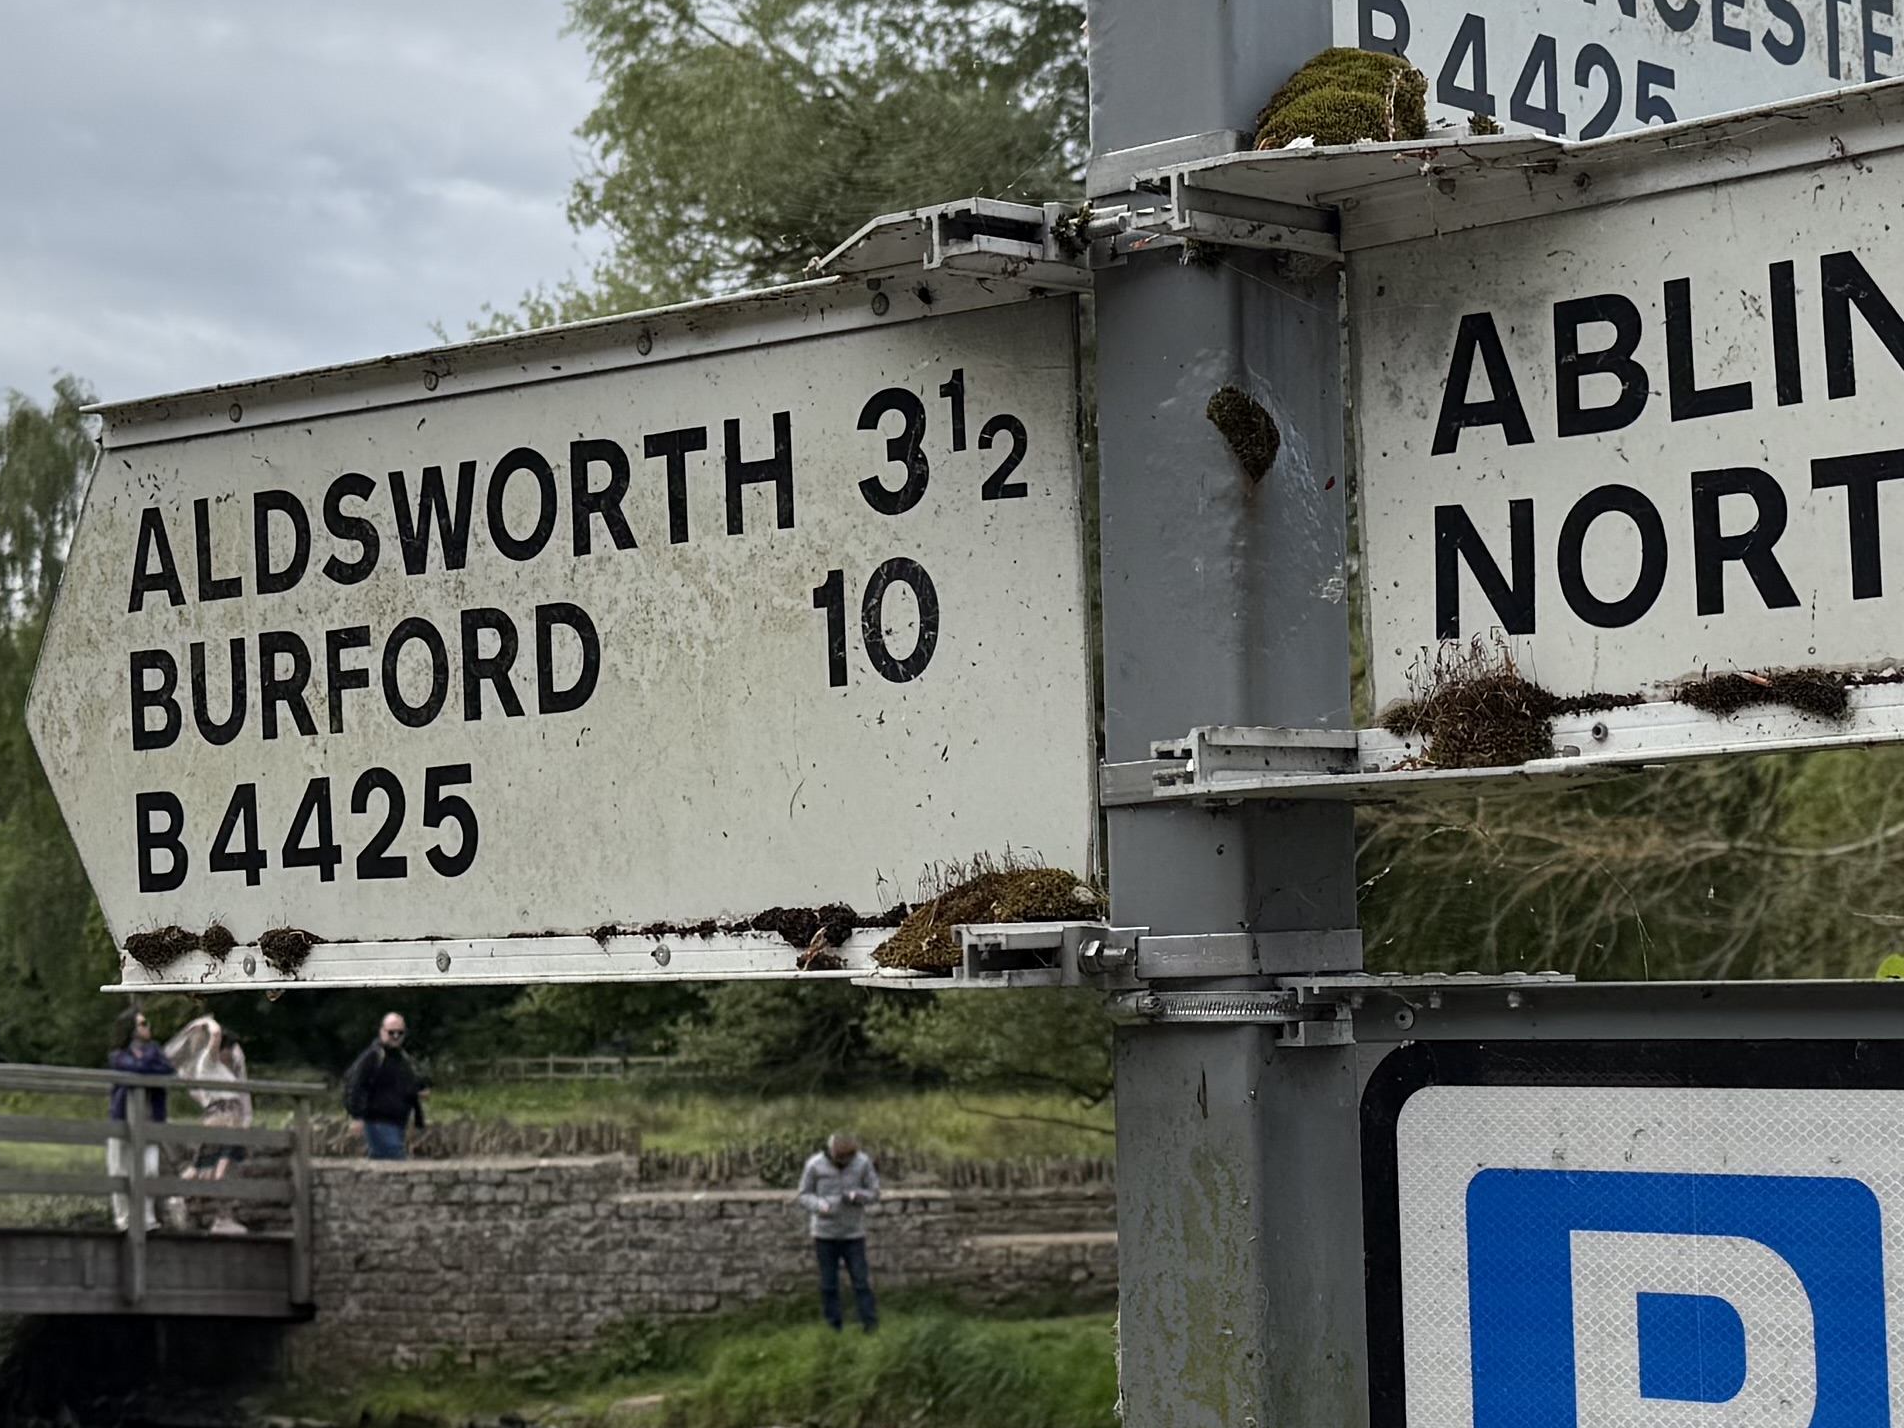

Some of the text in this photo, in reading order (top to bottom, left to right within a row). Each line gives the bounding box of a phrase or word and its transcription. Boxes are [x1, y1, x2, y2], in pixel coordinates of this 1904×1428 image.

[127, 410, 795, 614] ALDSWORTH
[129, 556, 940, 752] BURFORD 10
[135, 762, 479, 894] B4425
